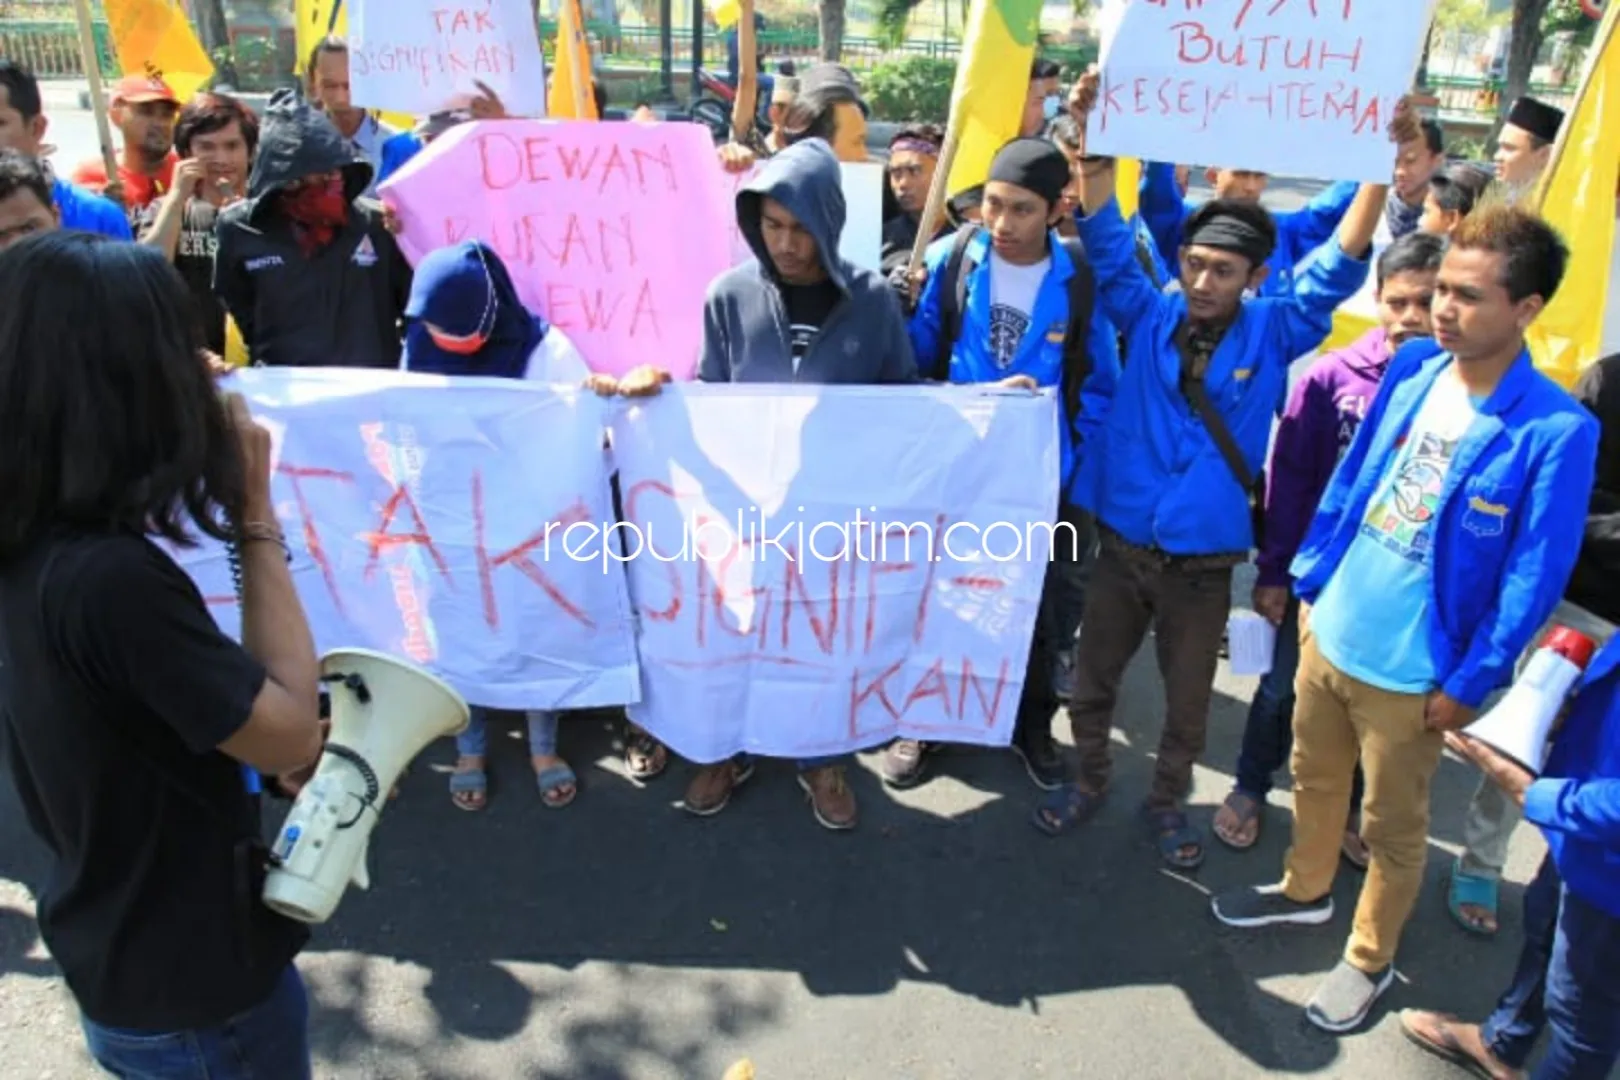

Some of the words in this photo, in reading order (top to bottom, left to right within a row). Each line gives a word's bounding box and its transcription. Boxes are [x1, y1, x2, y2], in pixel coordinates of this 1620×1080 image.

[431, 9, 496, 35] TAK
[1169, 22, 1363, 72] BUTUH
[1100, 70, 1394, 133] KESEJAHTERAA
[472, 130, 678, 193] DEWAN
[534, 278, 661, 339] EWA
[271, 463, 596, 632] TAK
[849, 655, 1009, 739] KAN
